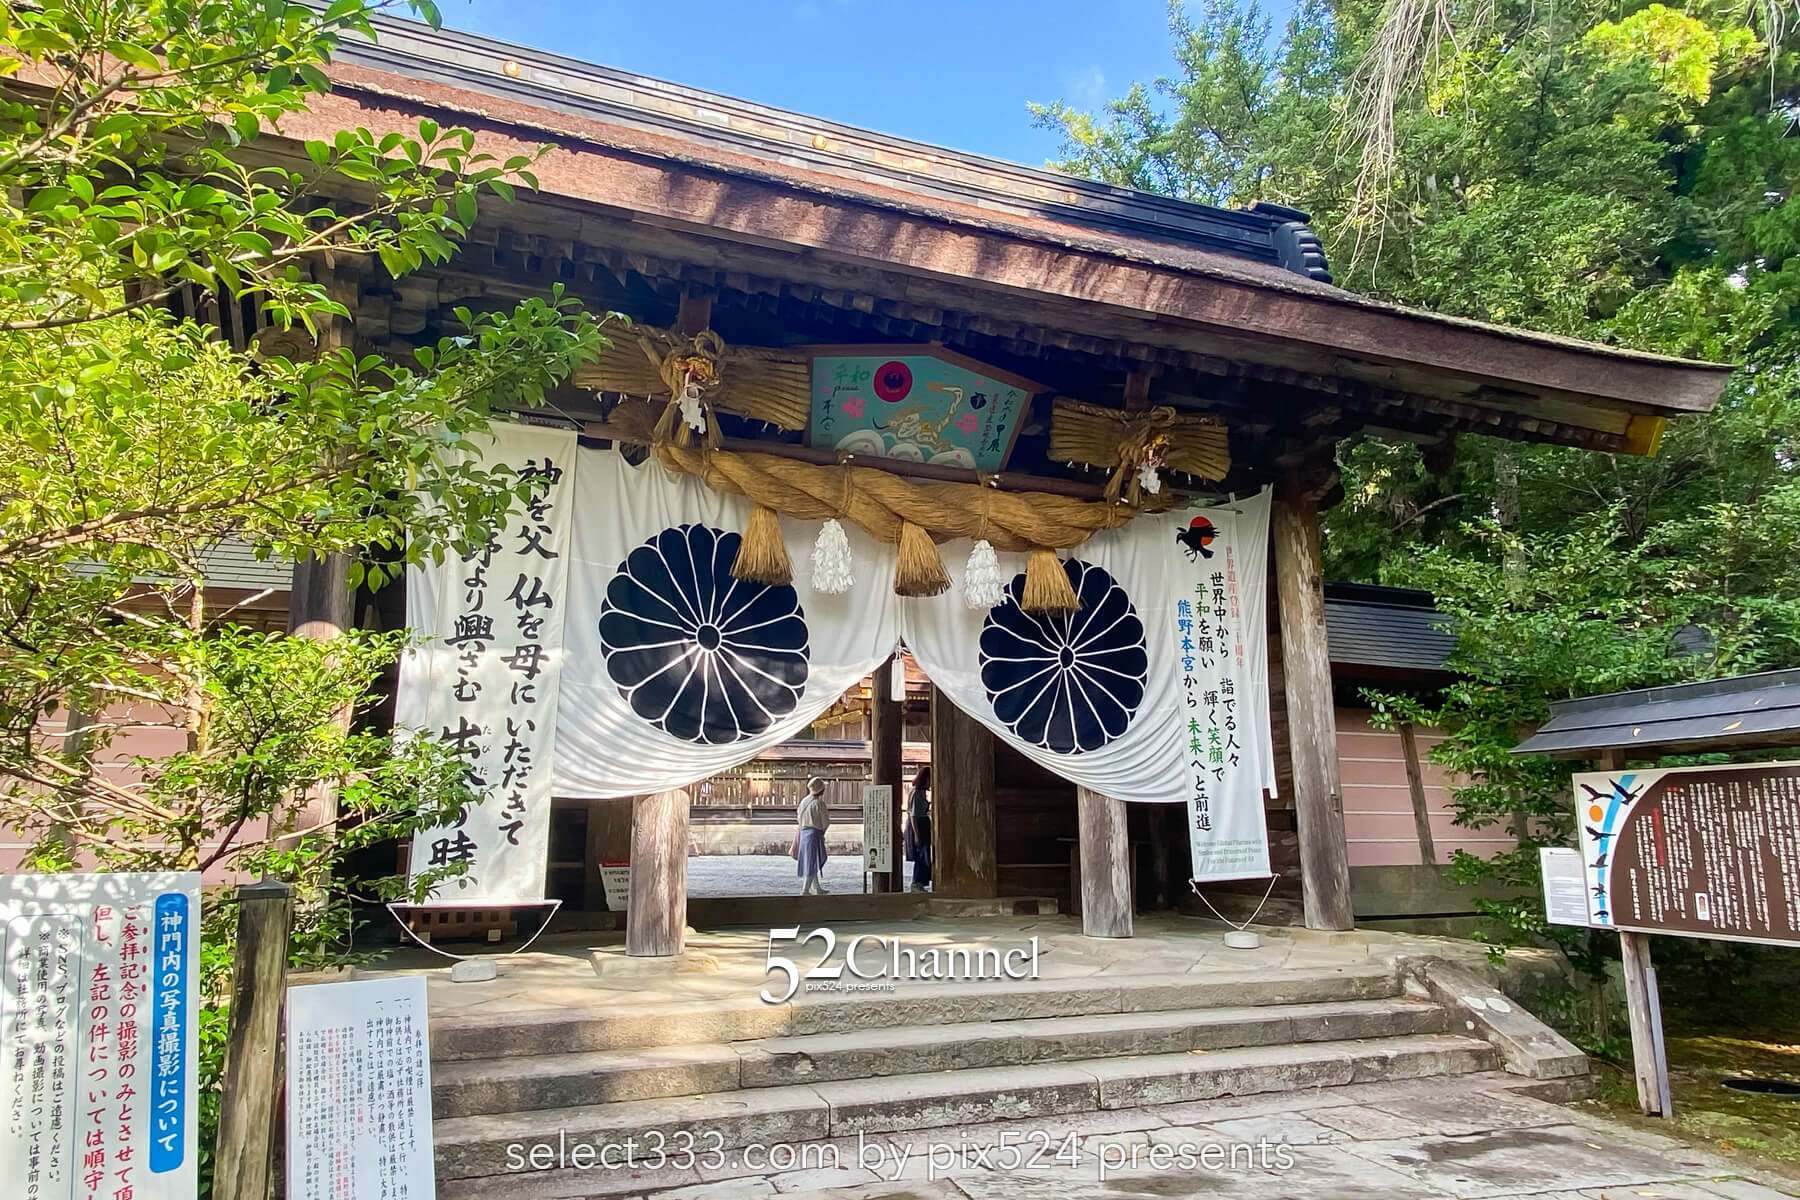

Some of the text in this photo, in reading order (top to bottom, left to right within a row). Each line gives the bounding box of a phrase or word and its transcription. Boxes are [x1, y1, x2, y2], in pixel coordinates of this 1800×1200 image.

[498, 457, 563, 845] 神を父 仏を母に いただきて
[1177, 600, 1212, 831] 熊野本宮から 未来へと前進
[1195, 583, 1225, 782] 平和を願い 輝く笑顔で
[1210, 571, 1240, 767] 世界中から 詣でる人々
[112, 905, 142, 1200] ご参拝記念の撮影のみとさせて頂
[157, 912, 183, 1151] 神門内の写真撮影について
